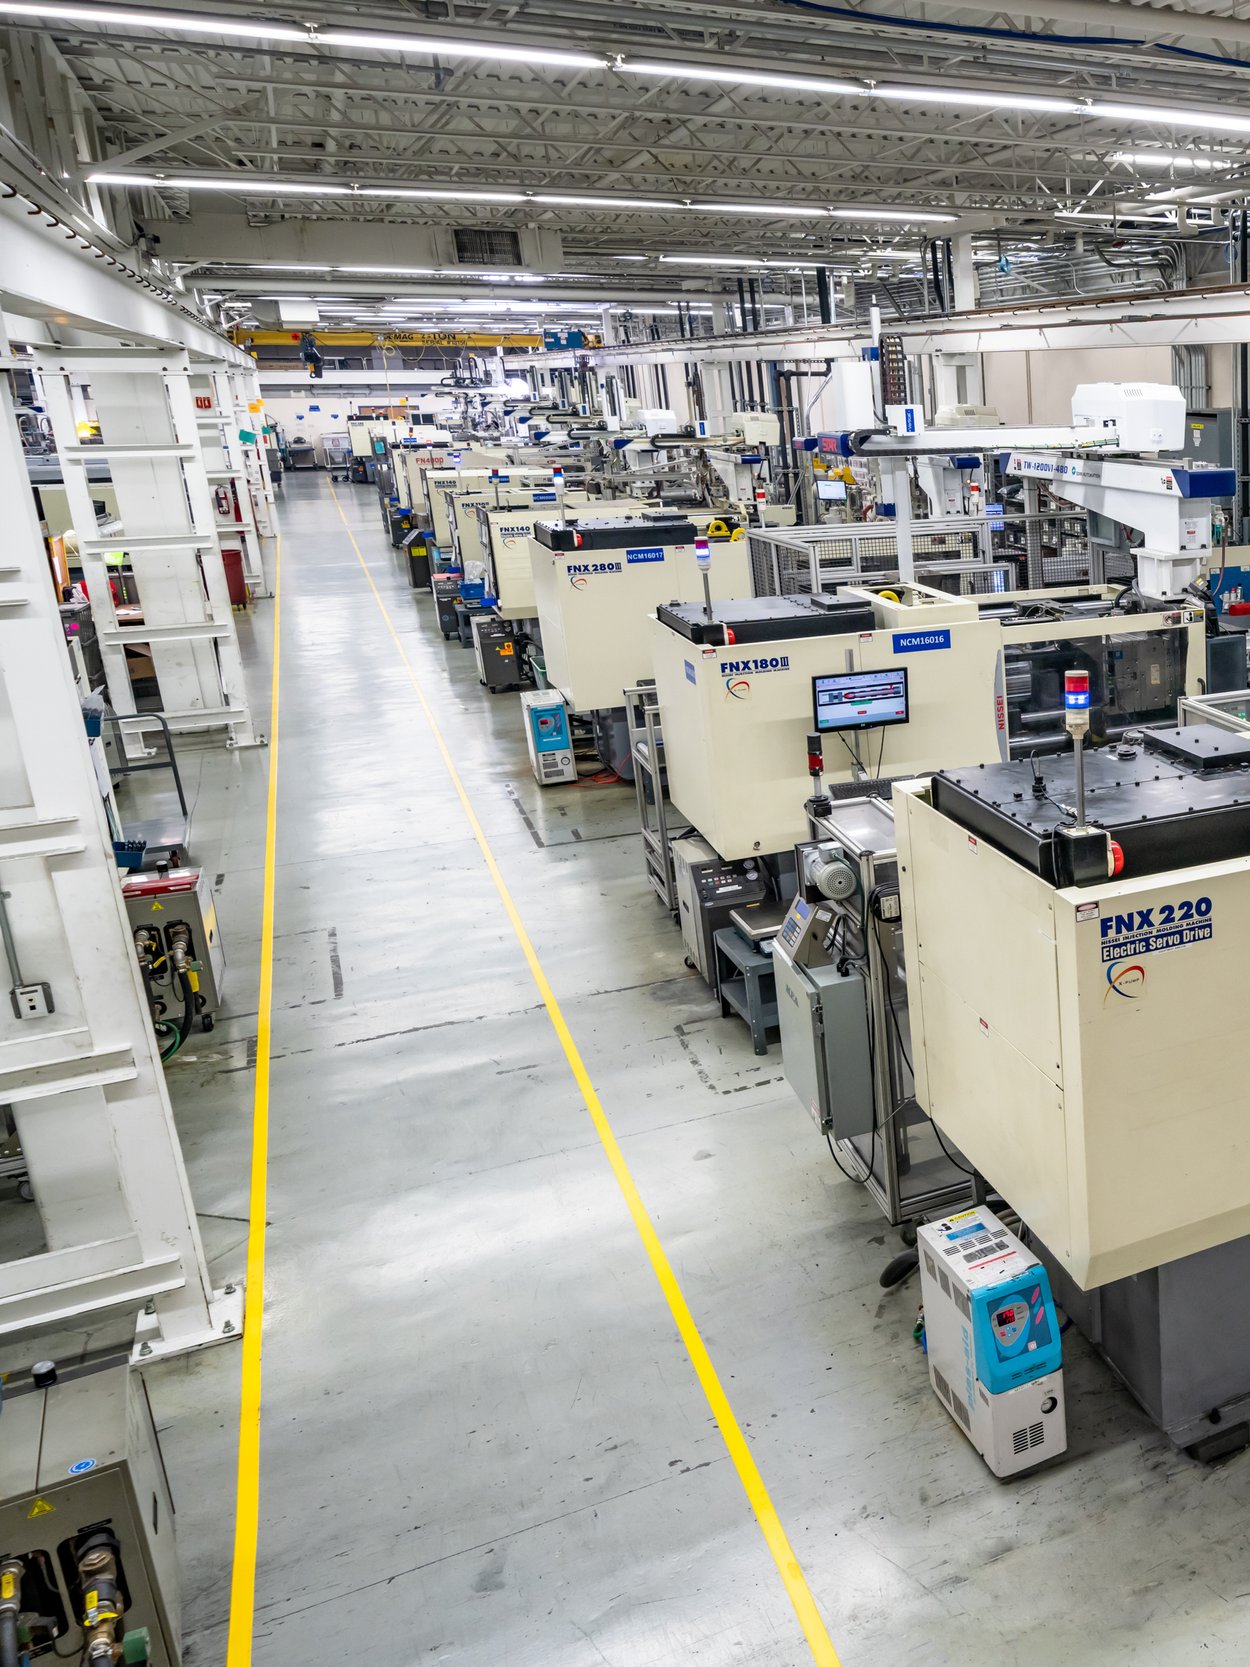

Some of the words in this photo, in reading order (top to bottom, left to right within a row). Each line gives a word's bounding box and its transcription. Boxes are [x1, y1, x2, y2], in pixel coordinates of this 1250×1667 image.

[627, 551, 663, 560] NCM16017
[900, 635, 944, 646] NCM16016
[996, 695, 1005, 731] NISSEI
[1101, 938, 1121, 946] NISSEI
[1122, 930, 1153, 941] INJECTION
[1156, 923, 1184, 933] MOLDING
[1185, 917, 1212, 927] MACHINE
[1103, 943, 1146, 961] Electric
[1149, 934, 1180, 950] Servo
[1183, 927, 1211, 943] Drive
